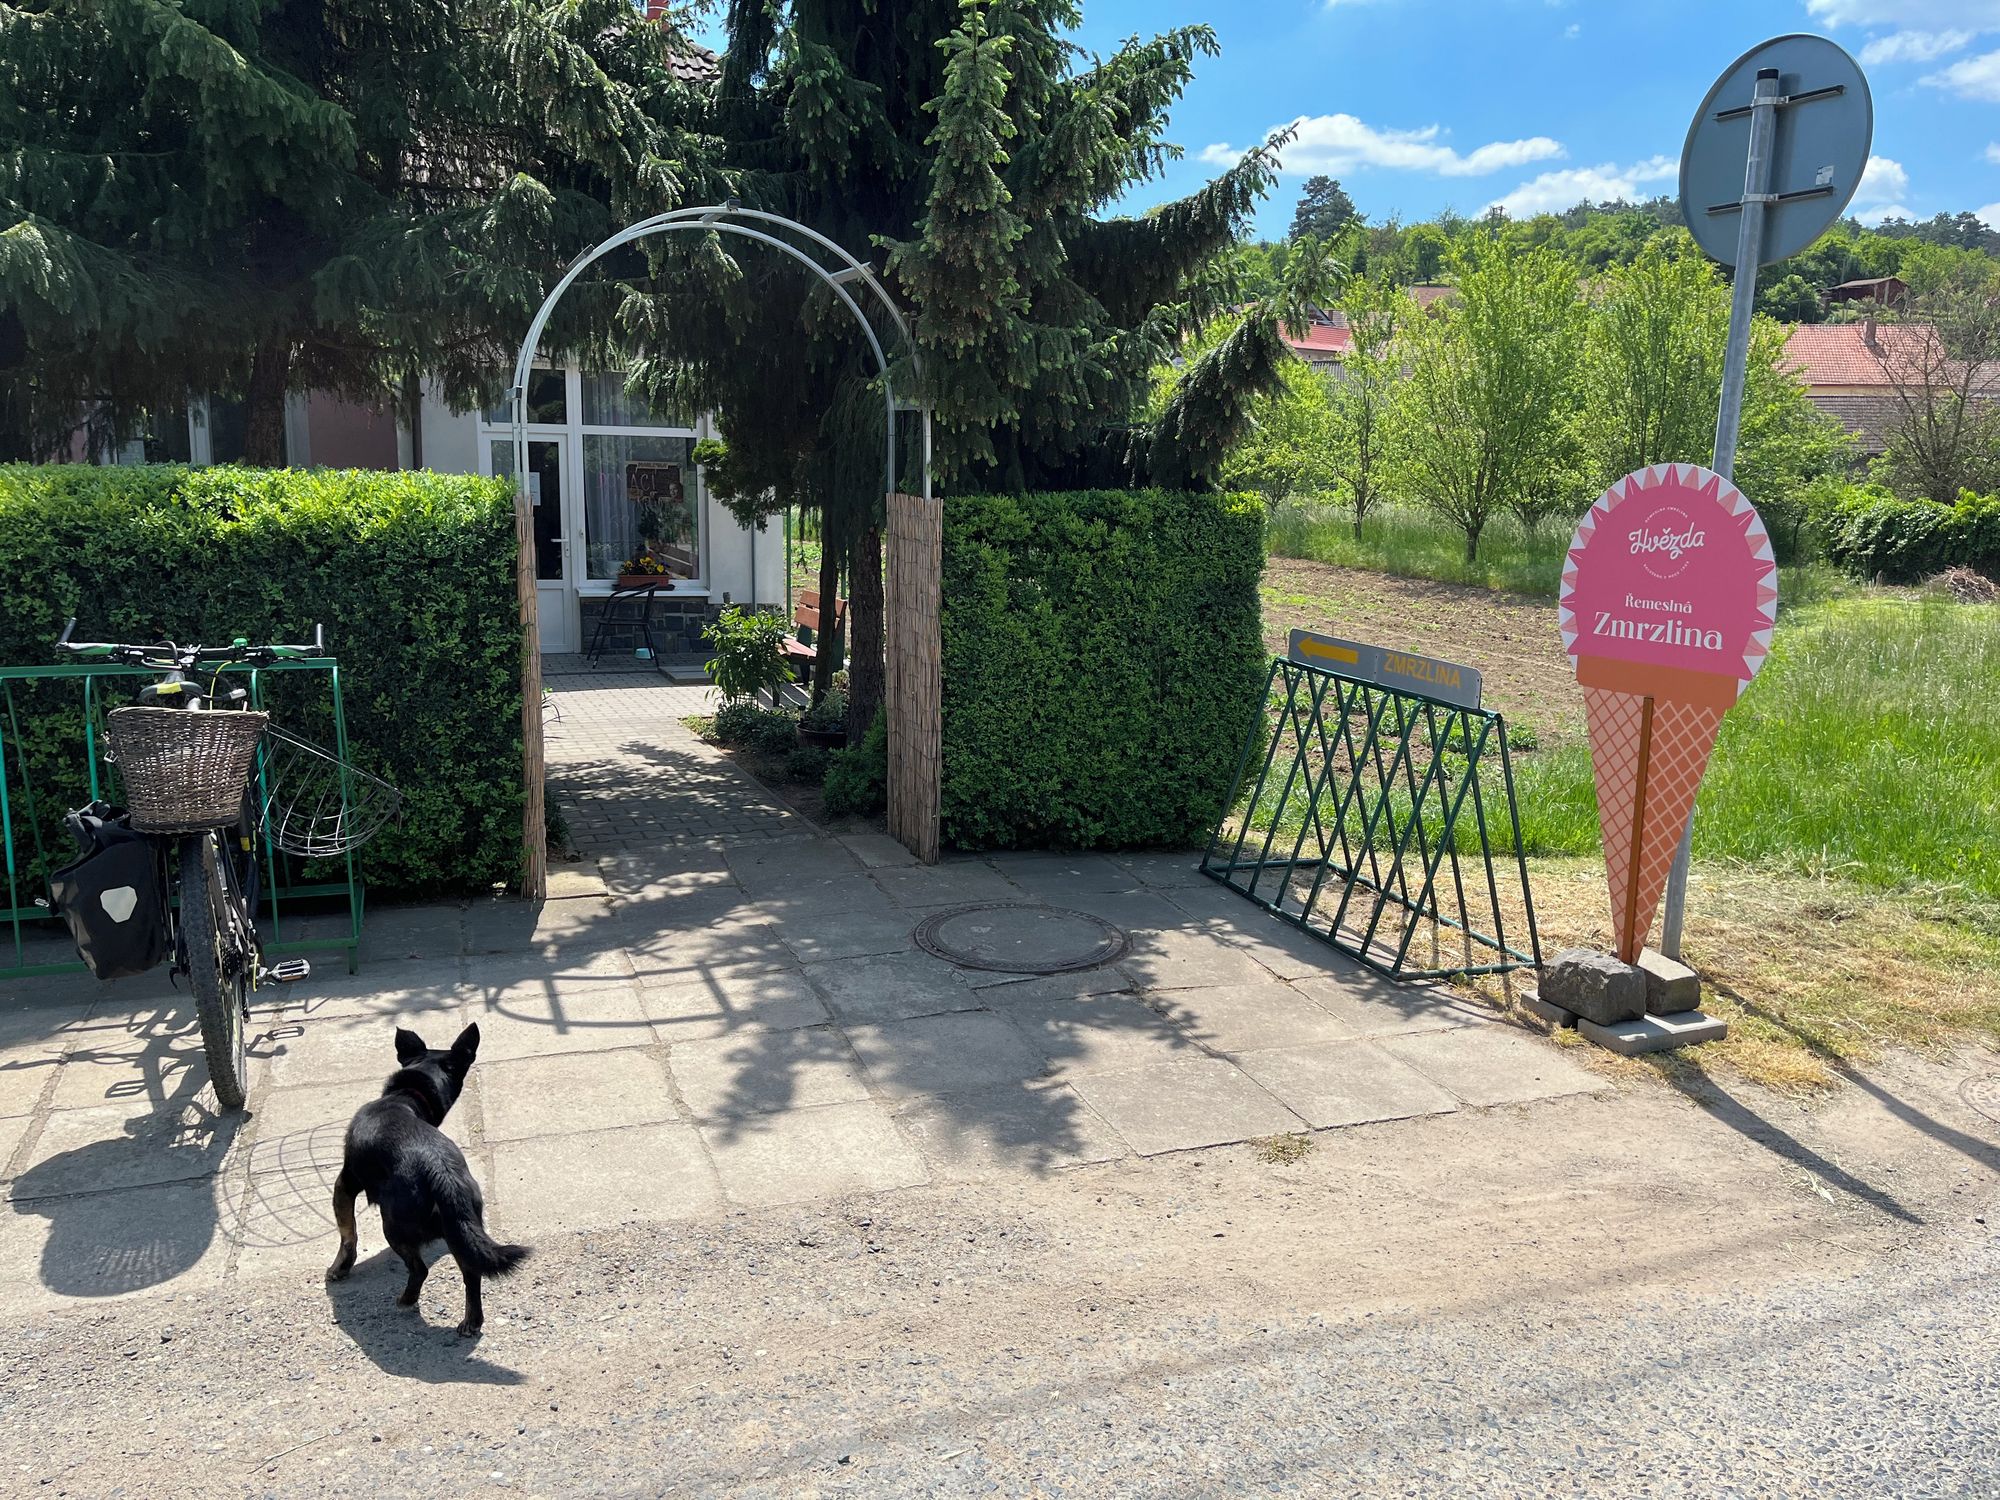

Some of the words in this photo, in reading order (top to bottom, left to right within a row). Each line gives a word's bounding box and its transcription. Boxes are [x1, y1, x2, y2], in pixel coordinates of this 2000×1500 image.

[1628, 521, 1705, 560] Hvězda
[1625, 593, 1692, 614] Řemeslná
[1593, 611, 1723, 650] Zmrzlina
[1384, 653, 1461, 688] ZMRZLINA
